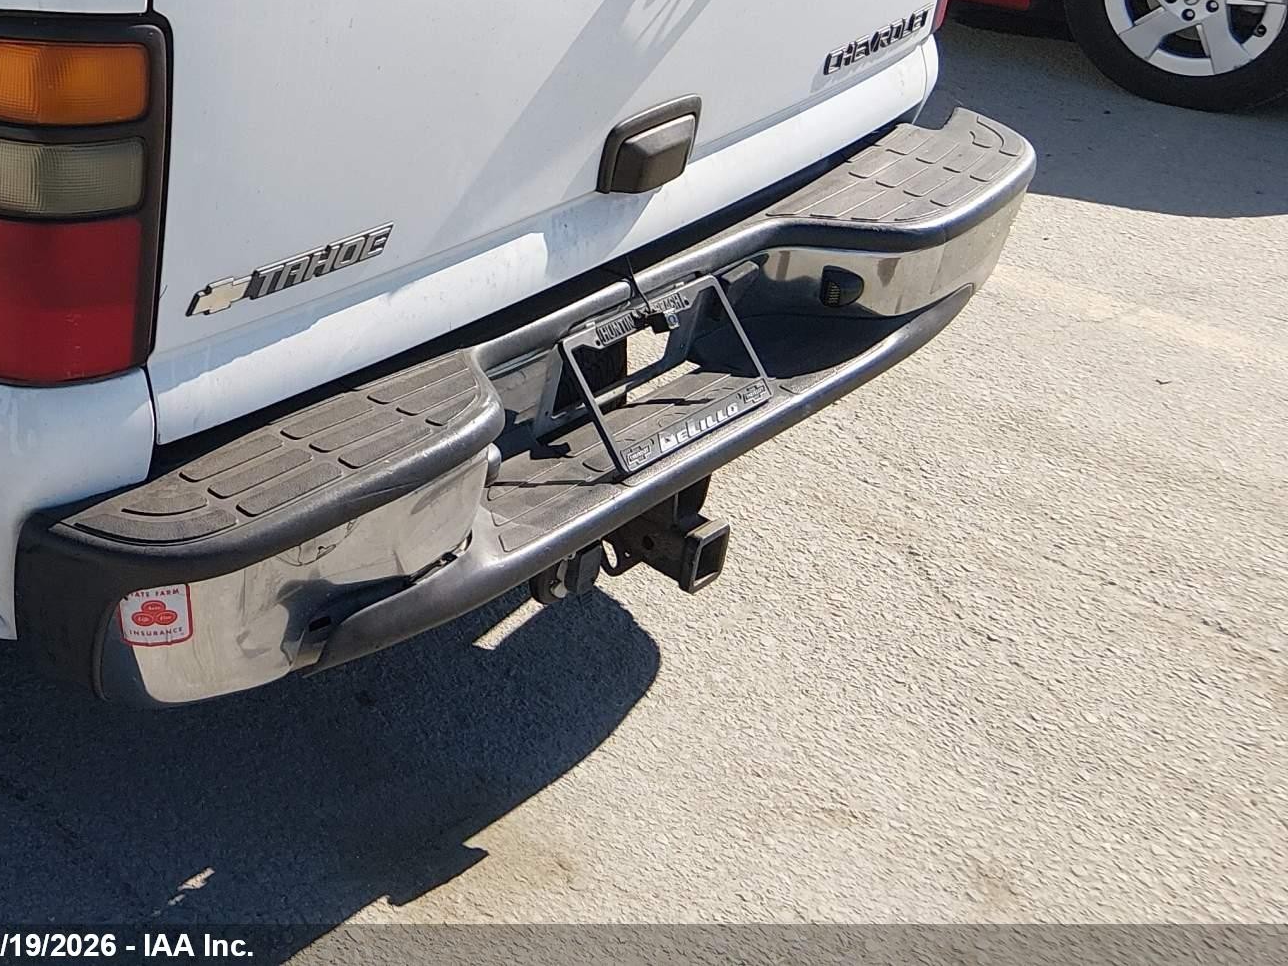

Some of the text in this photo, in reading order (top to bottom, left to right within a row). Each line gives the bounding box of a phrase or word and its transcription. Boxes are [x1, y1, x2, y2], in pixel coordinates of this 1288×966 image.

[822, 2, 934, 75] CHEVROLET
[255, 220, 394, 299] TAHOE
[129, 627, 183, 636] INSURANCE
